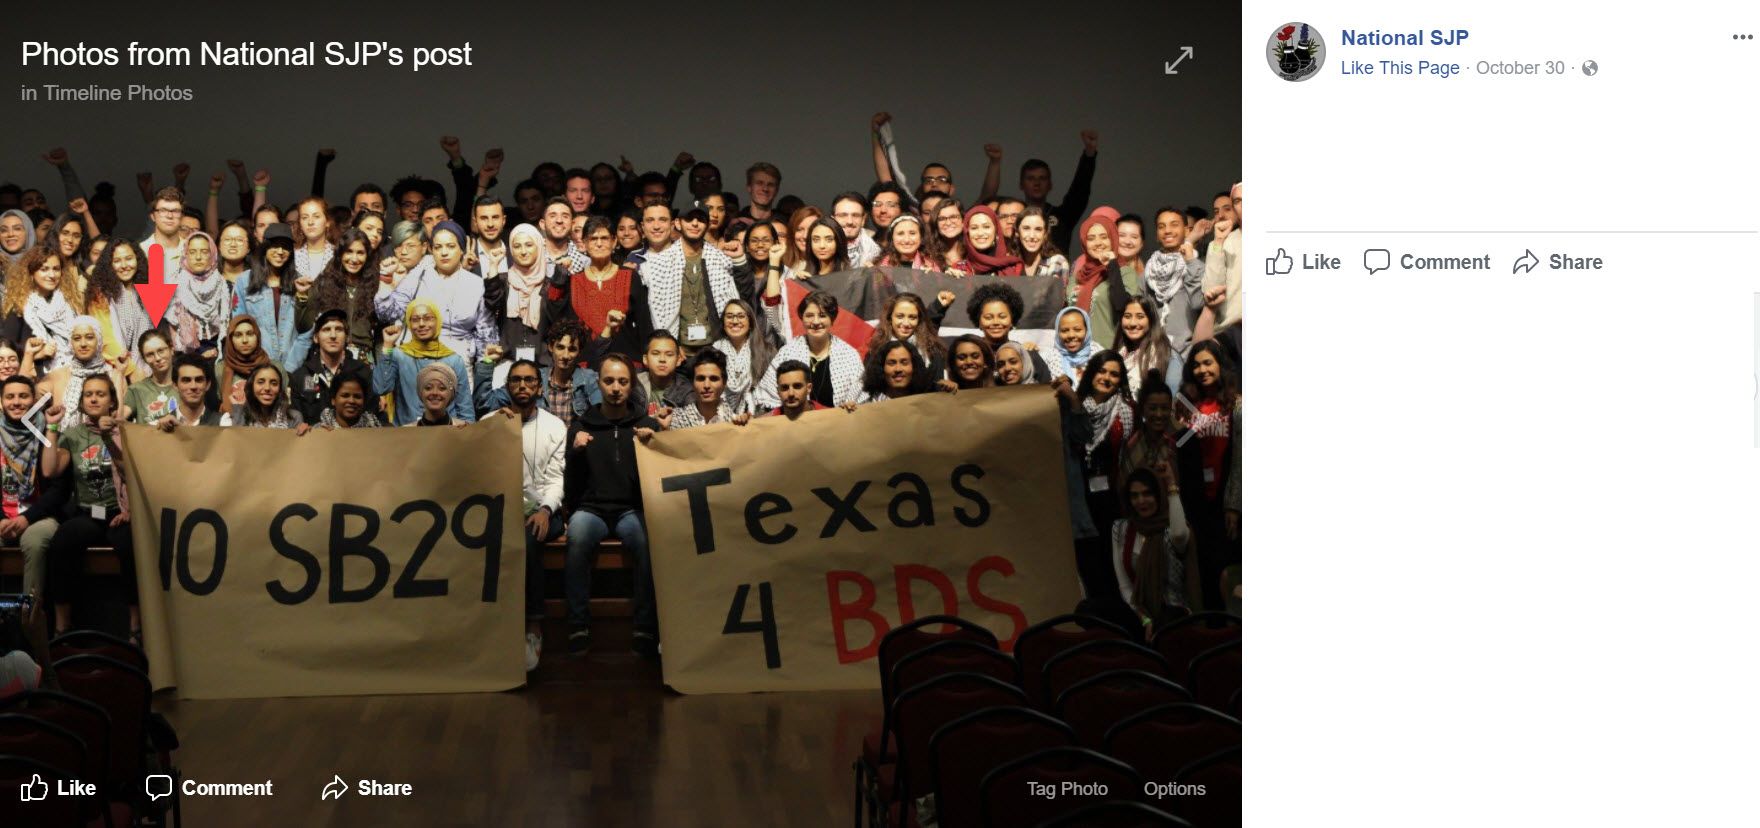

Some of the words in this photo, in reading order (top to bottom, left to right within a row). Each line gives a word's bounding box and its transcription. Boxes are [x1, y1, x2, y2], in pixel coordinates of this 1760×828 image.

[265, 493, 505, 605] SB29
[661, 463, 992, 556] Texas
[721, 580, 782, 669] 4
[825, 555, 1029, 665] BDS
